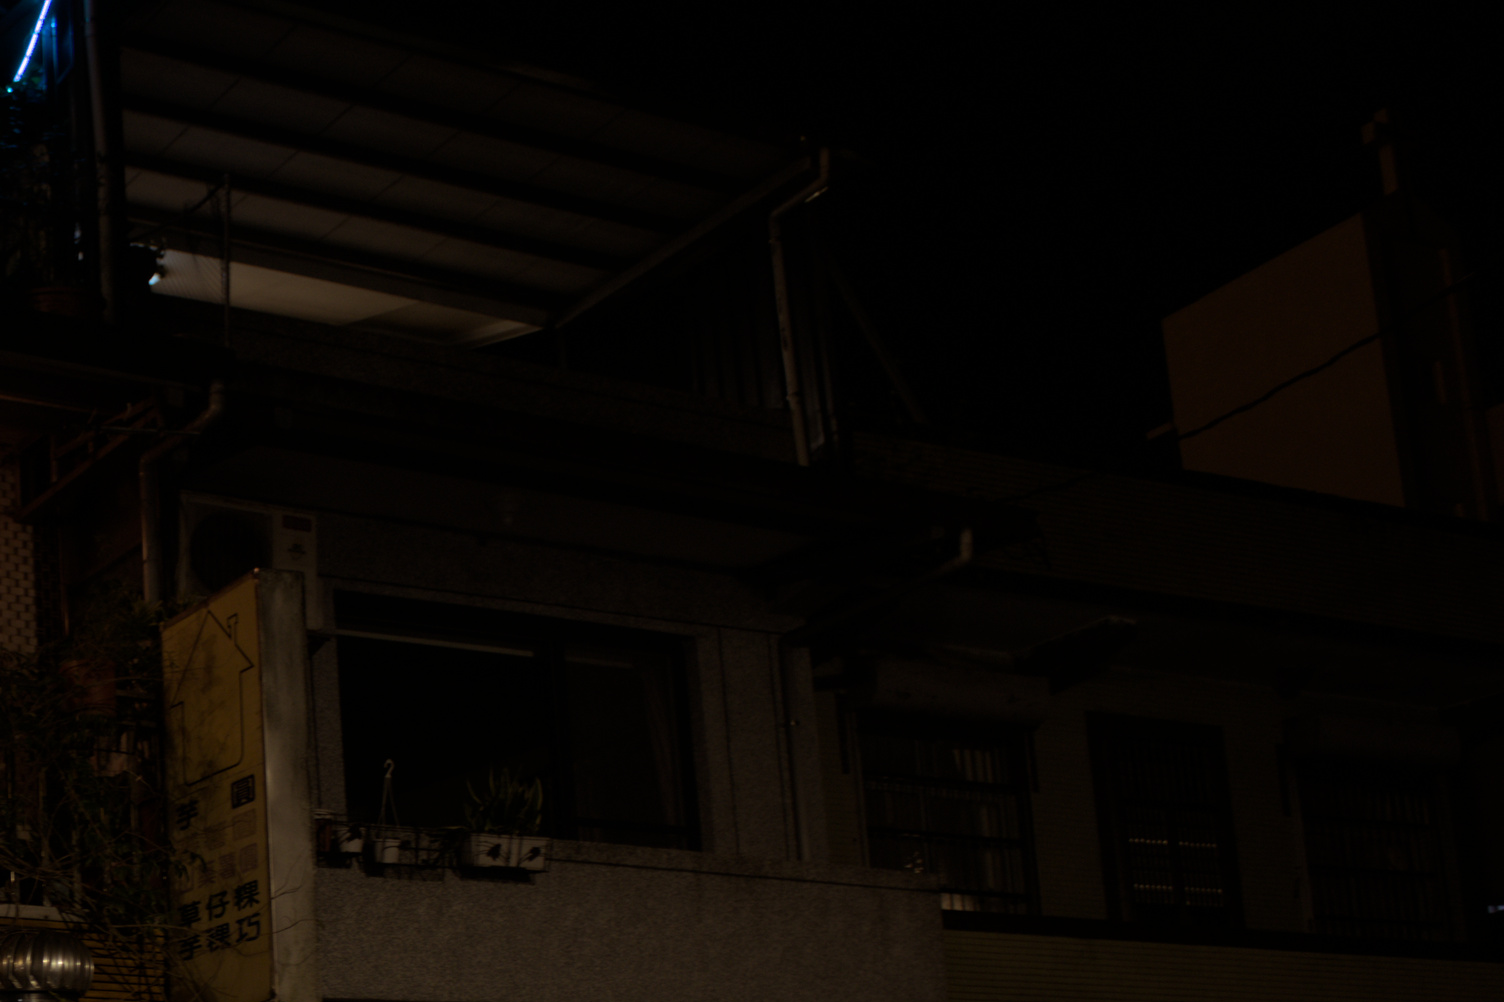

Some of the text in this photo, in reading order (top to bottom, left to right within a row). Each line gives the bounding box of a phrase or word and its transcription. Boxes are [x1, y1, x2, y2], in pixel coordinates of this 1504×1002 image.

[178, 879, 260, 928] 草仔粿
[178, 912, 261, 961] 芋粿巧
